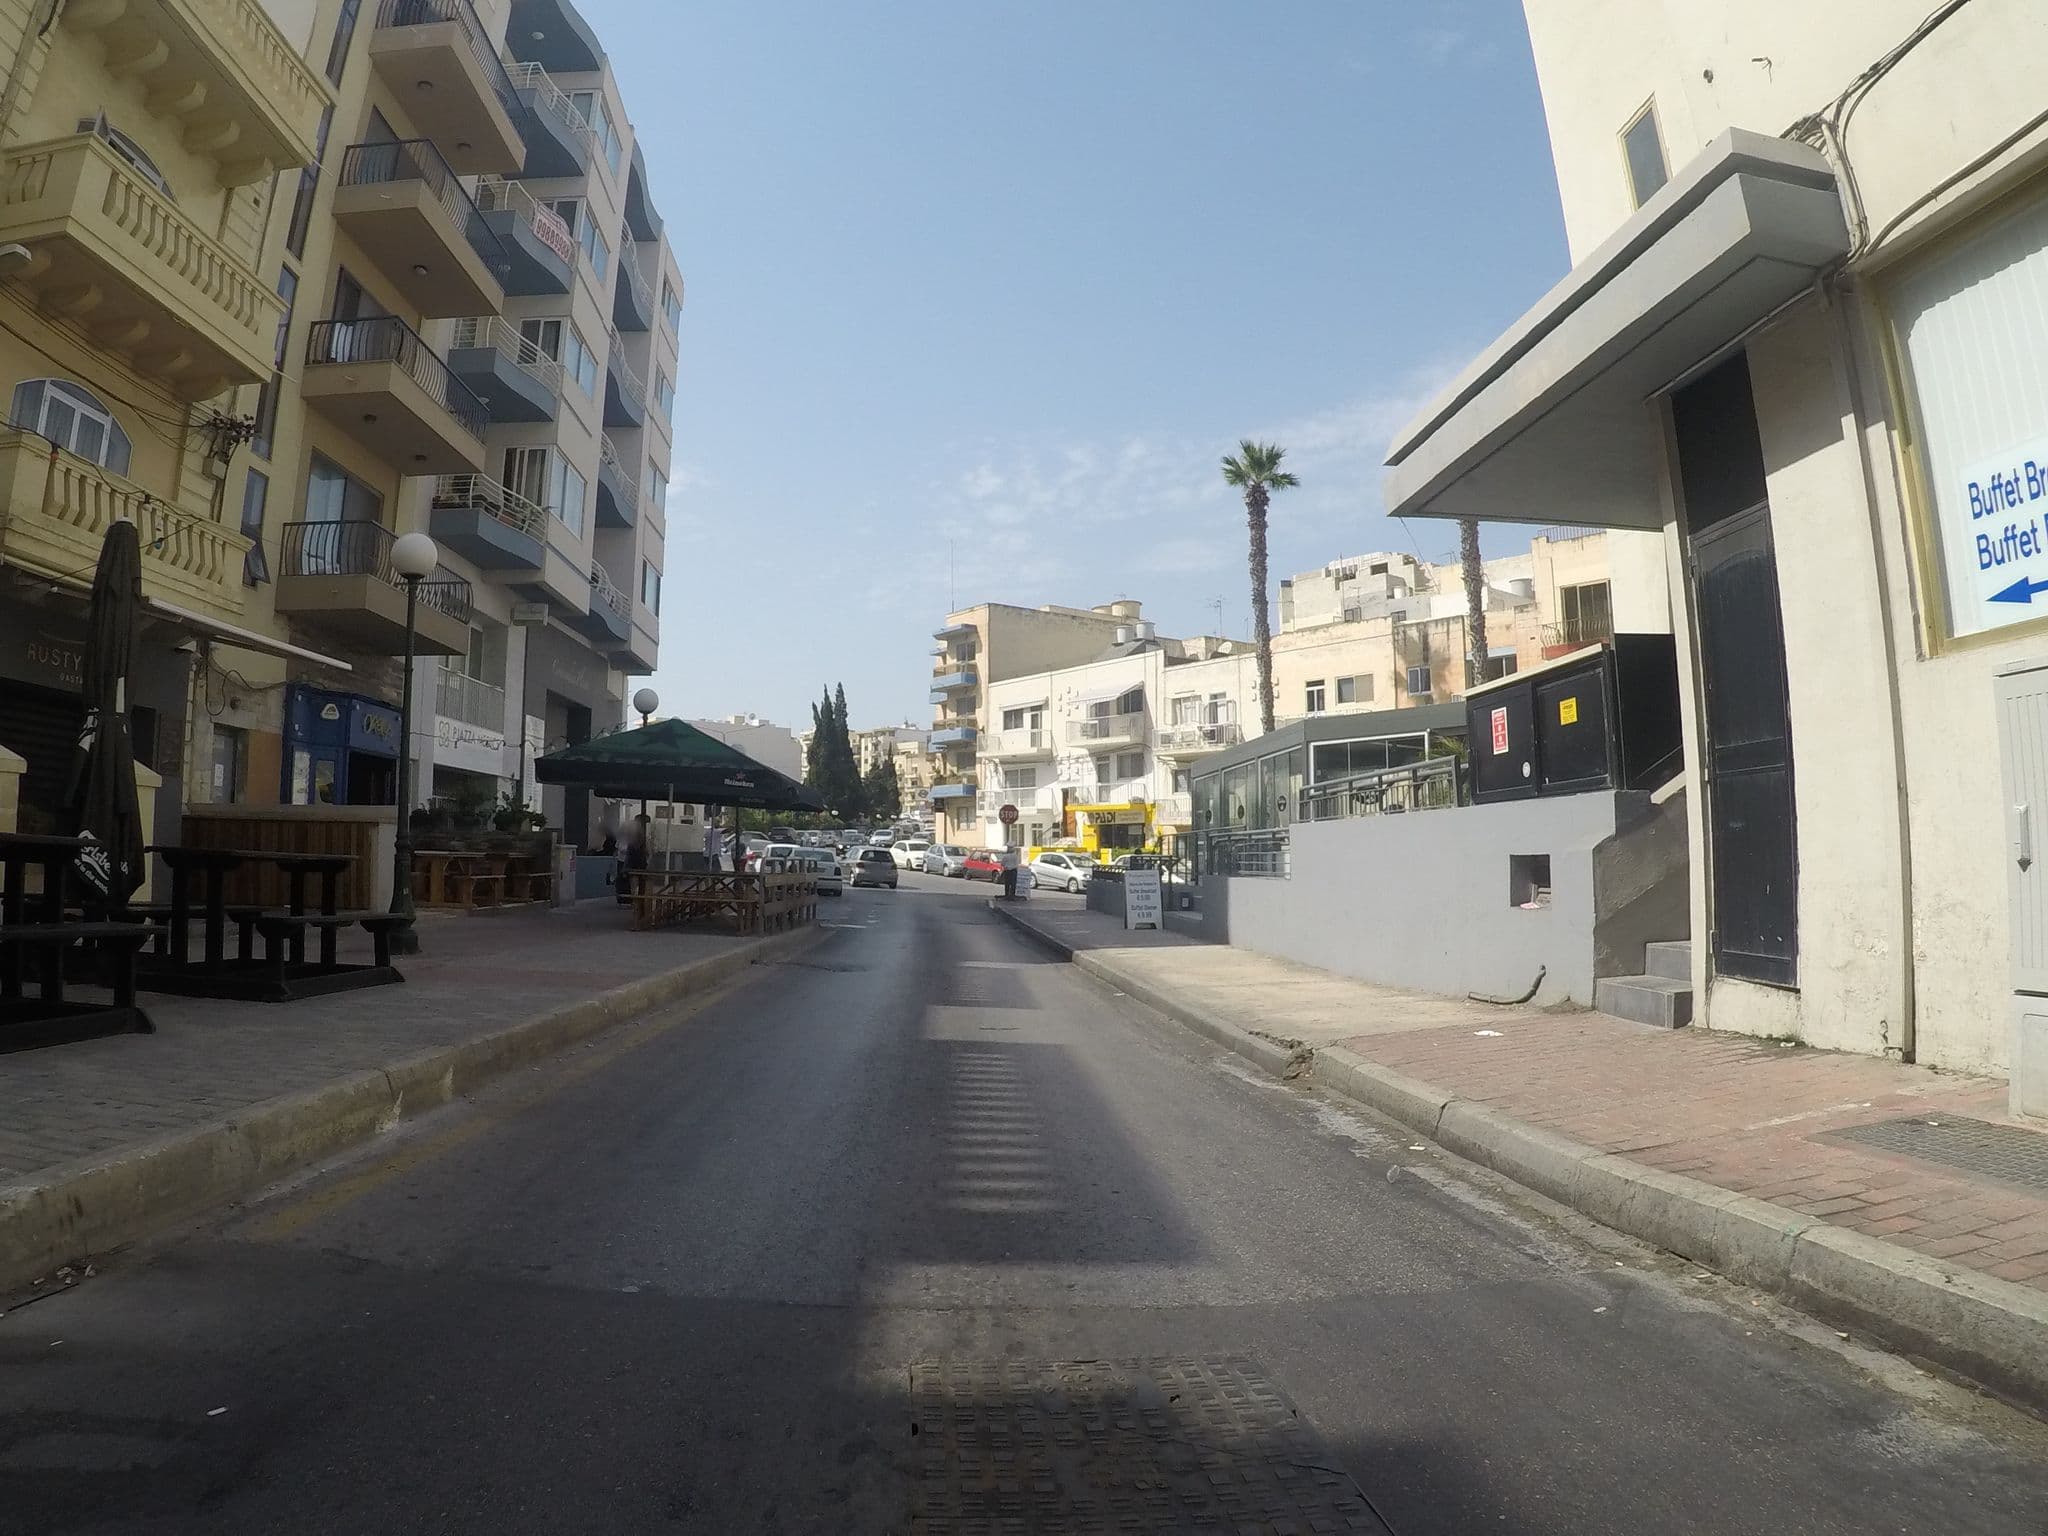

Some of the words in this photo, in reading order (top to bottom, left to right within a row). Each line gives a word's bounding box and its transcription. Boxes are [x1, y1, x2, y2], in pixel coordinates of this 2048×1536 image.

[1968, 468, 2024, 520] Buffet
[2024, 460, 2048, 501] Br
[1976, 519, 2041, 570] Buffet
[28, 642, 82, 671] RUSTY
[1000, 811, 1017, 819] STOP
[1095, 811, 1116, 824] PADI
